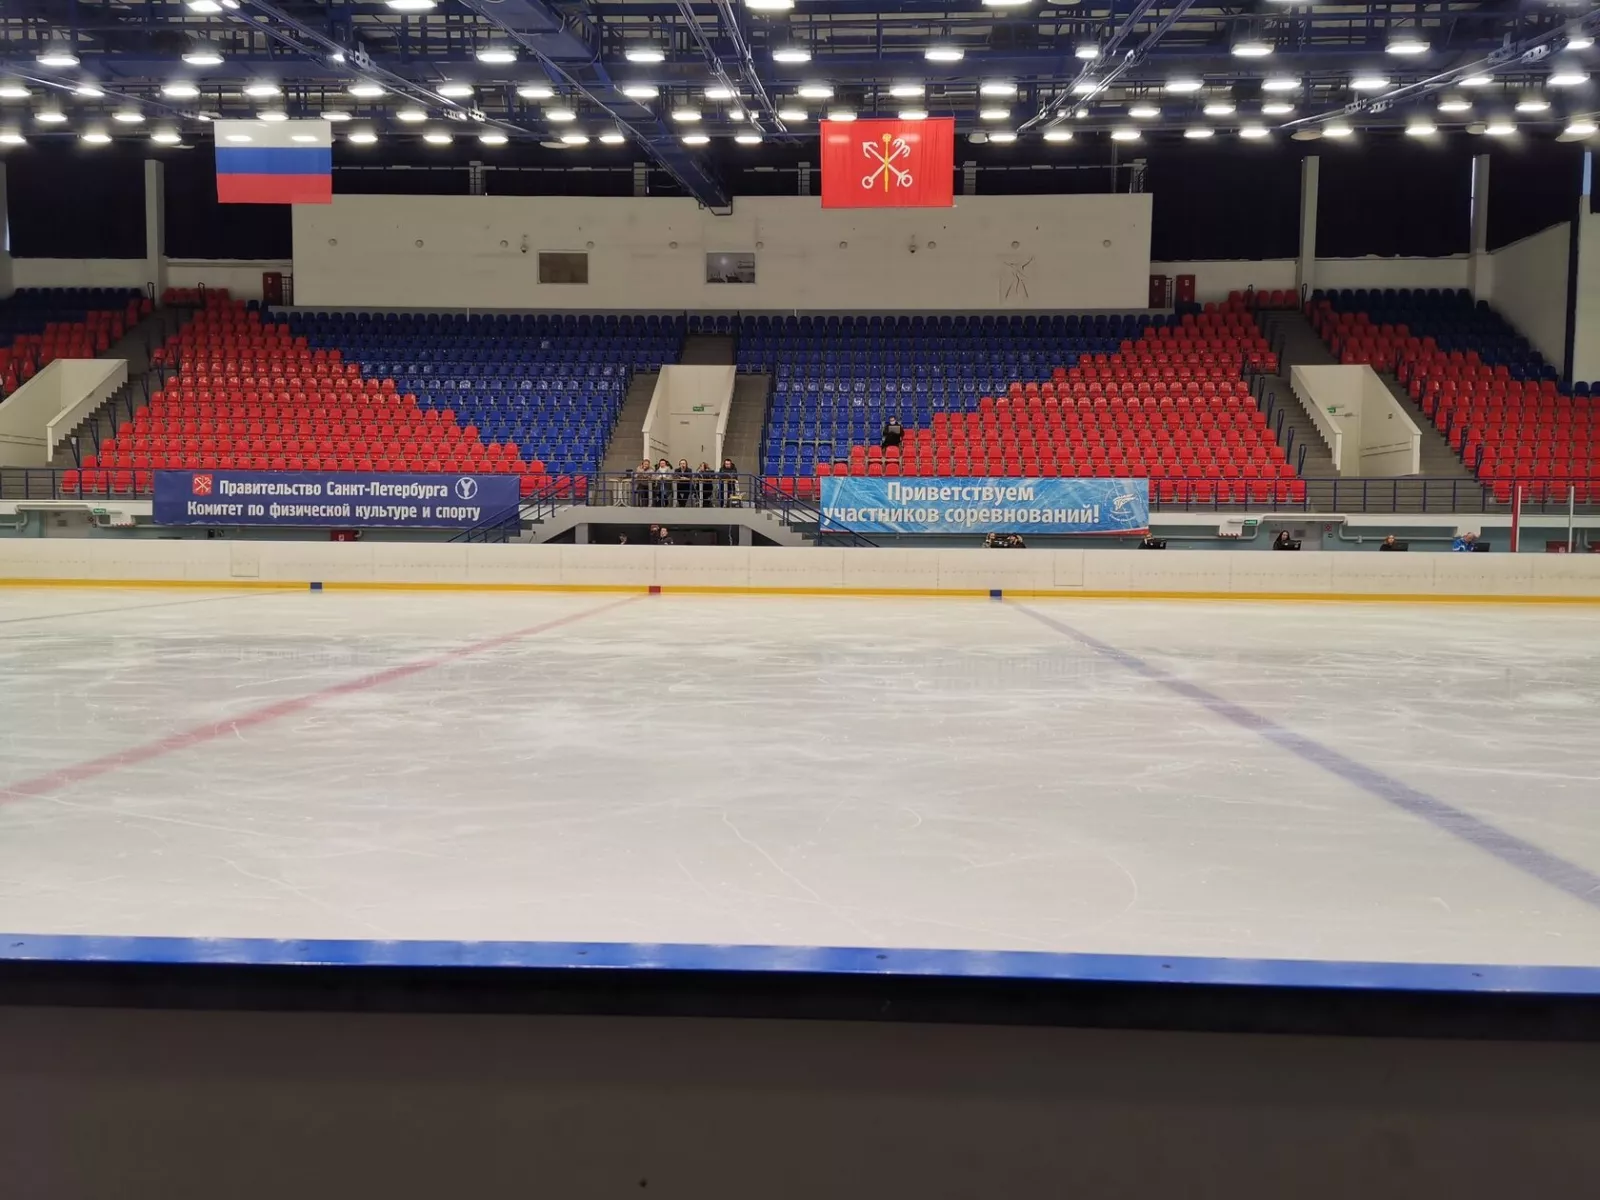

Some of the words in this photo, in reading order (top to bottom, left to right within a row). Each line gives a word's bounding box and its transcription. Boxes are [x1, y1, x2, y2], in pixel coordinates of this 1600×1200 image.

[219, 480, 322, 497] Правительство
[326, 481, 448, 499] Санкт-Петербурга
[887, 481, 1034, 506] Приветствуем
[187, 501, 243, 516] Комитет
[248, 504, 264, 516] по
[269, 502, 350, 518] физической
[355, 504, 417, 520] культуре
[422, 506, 431, 518] и
[435, 506, 481, 521] спорту
[823, 506, 940, 526] участников
[944, 504, 1100, 527] соревнований!
